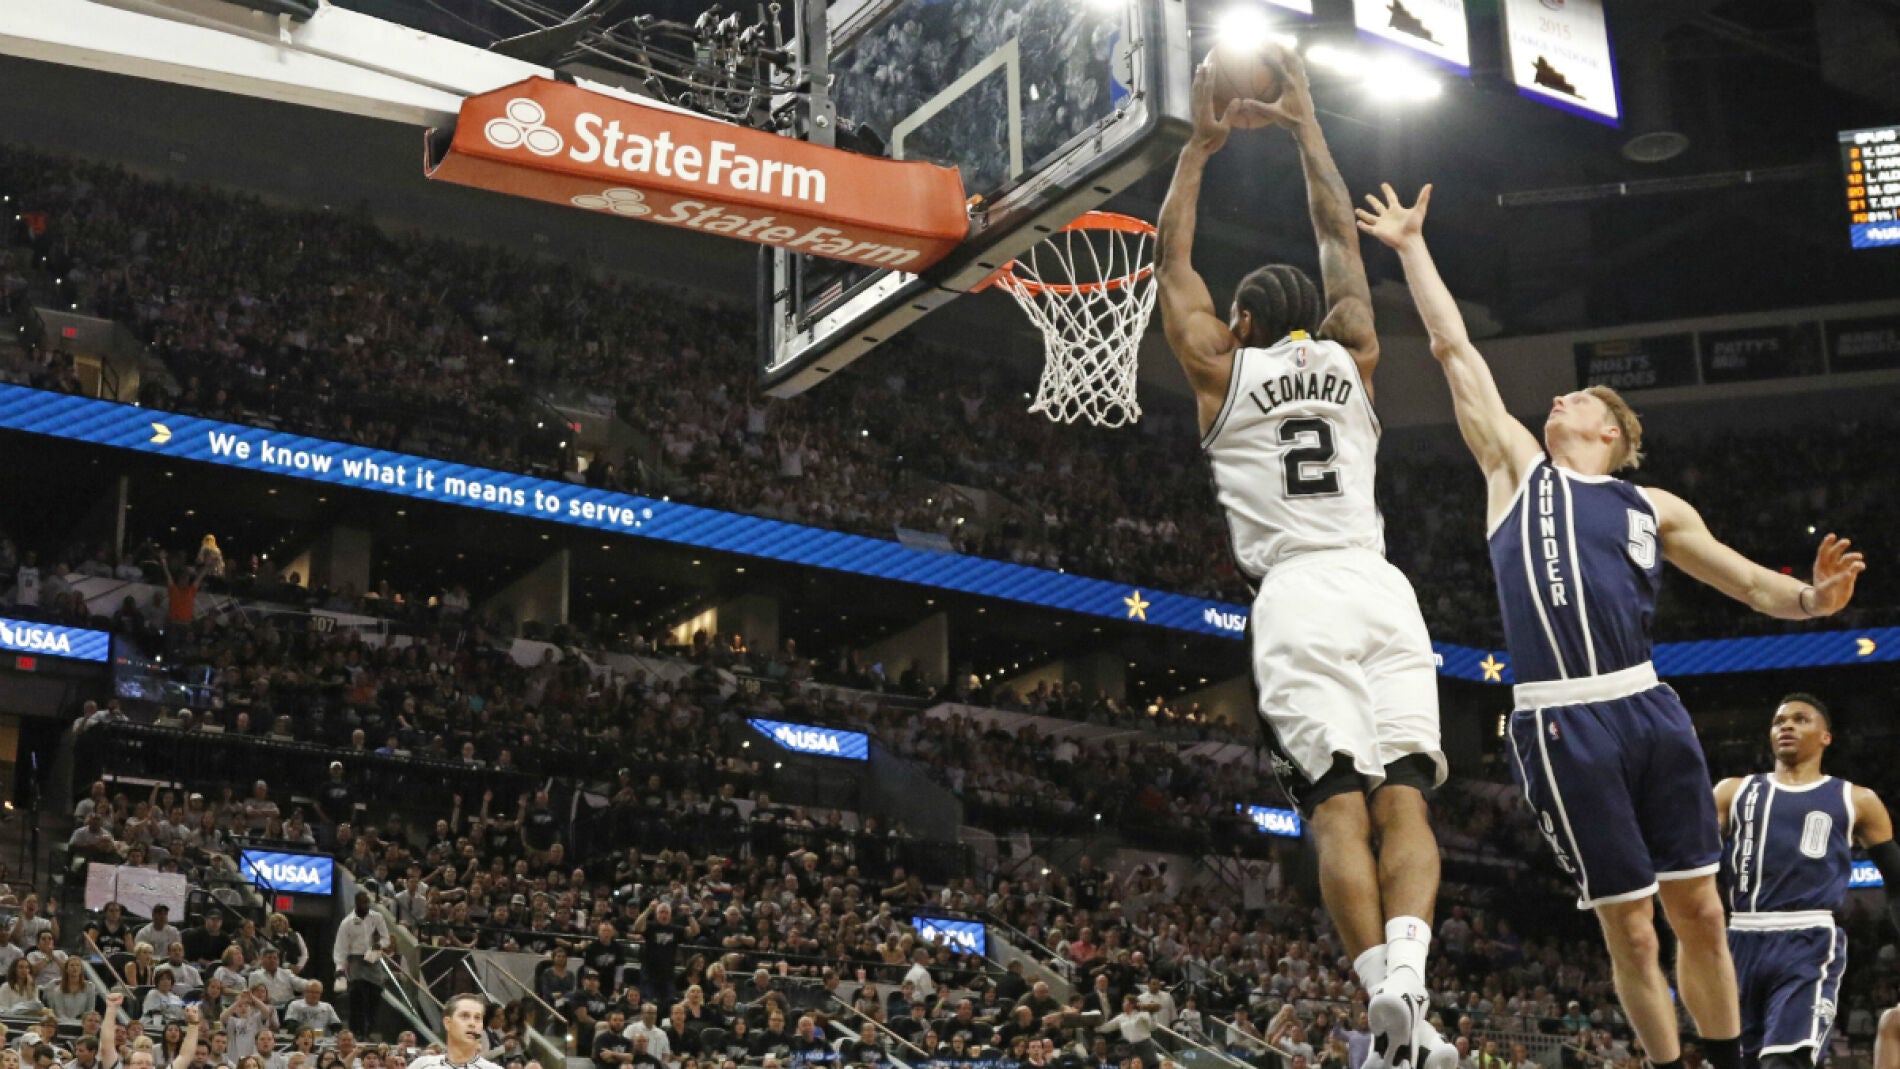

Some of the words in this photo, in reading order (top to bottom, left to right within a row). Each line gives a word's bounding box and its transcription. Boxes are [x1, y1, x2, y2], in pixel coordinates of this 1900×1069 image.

[1249, 372, 1353, 415] LEONARD
[208, 430, 250, 459] We
[261, 440, 332, 473] know
[342, 458, 406, 486] what
[416, 467, 435, 491] it
[445, 477, 525, 506] means
[535, 488, 560, 512] to
[1276, 416, 1344, 499] 2
[1538, 466, 1568, 607] THUNDER
[1626, 508, 1657, 569] 5
[15, 626, 71, 652] USAA
[797, 731, 839, 752] USAA
[1739, 782, 1762, 893] THUNDER
[1800, 810, 1833, 859] 0
[273, 864, 320, 885] USAA
